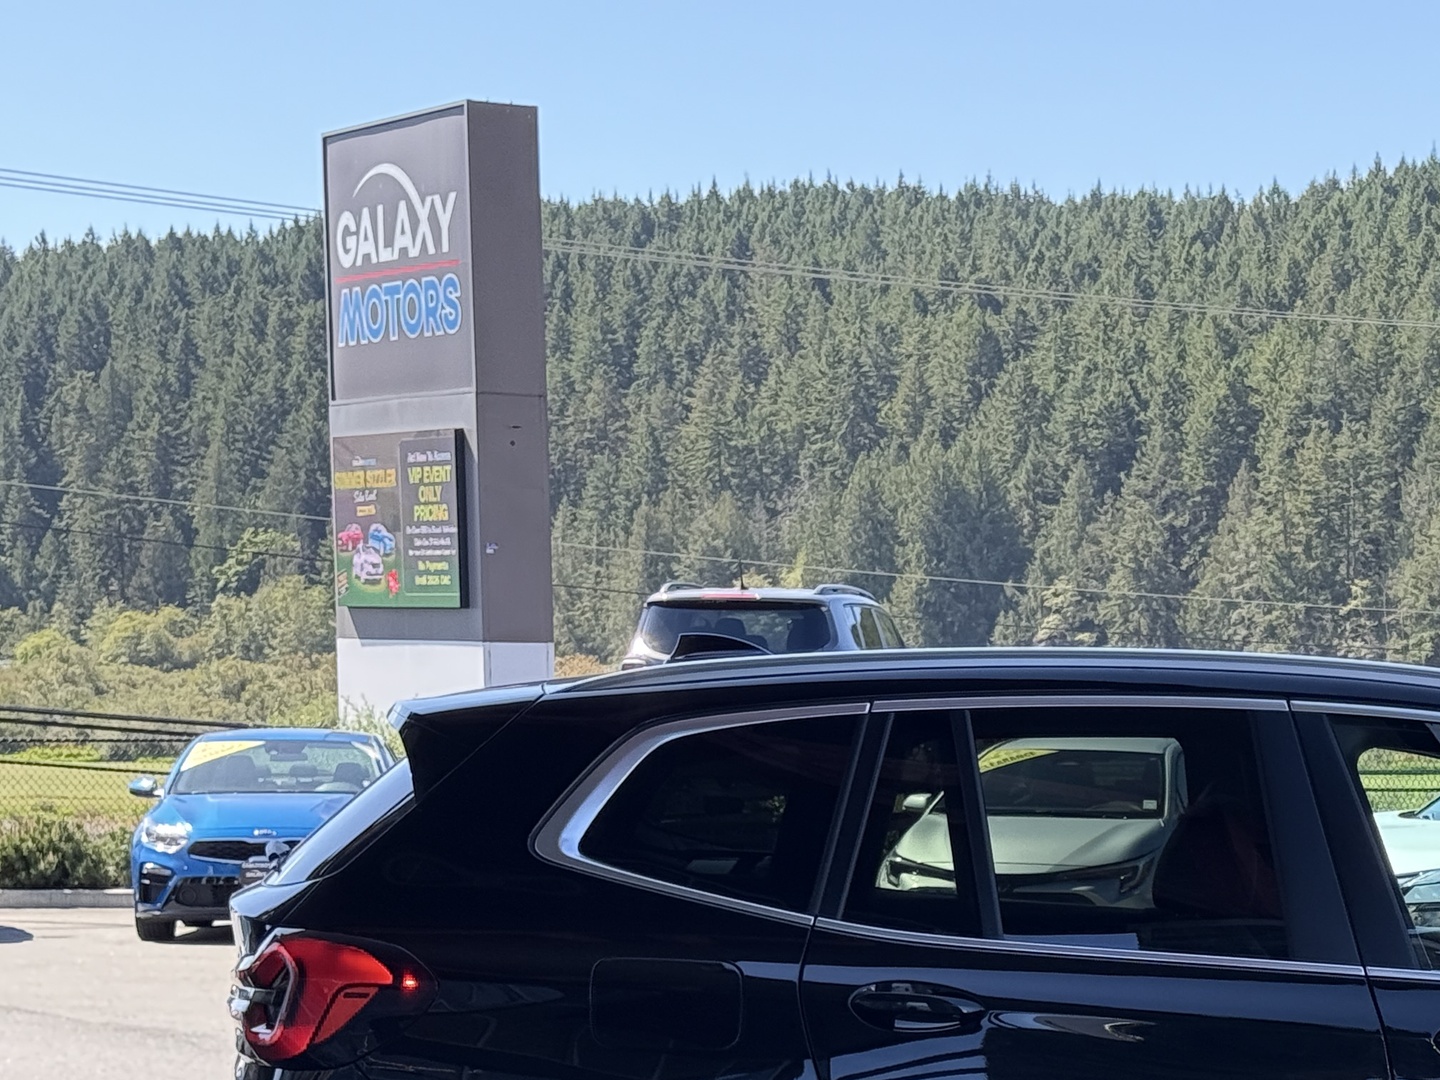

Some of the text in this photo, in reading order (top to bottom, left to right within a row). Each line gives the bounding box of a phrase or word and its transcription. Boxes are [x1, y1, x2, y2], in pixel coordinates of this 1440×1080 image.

[336, 191, 457, 268] GALAXY
[337, 273, 461, 347] MOTORS
[407, 464, 452, 484] VIP EVENT
[418, 485, 442, 503] ONLY
[413, 503, 449, 522] PRICING
